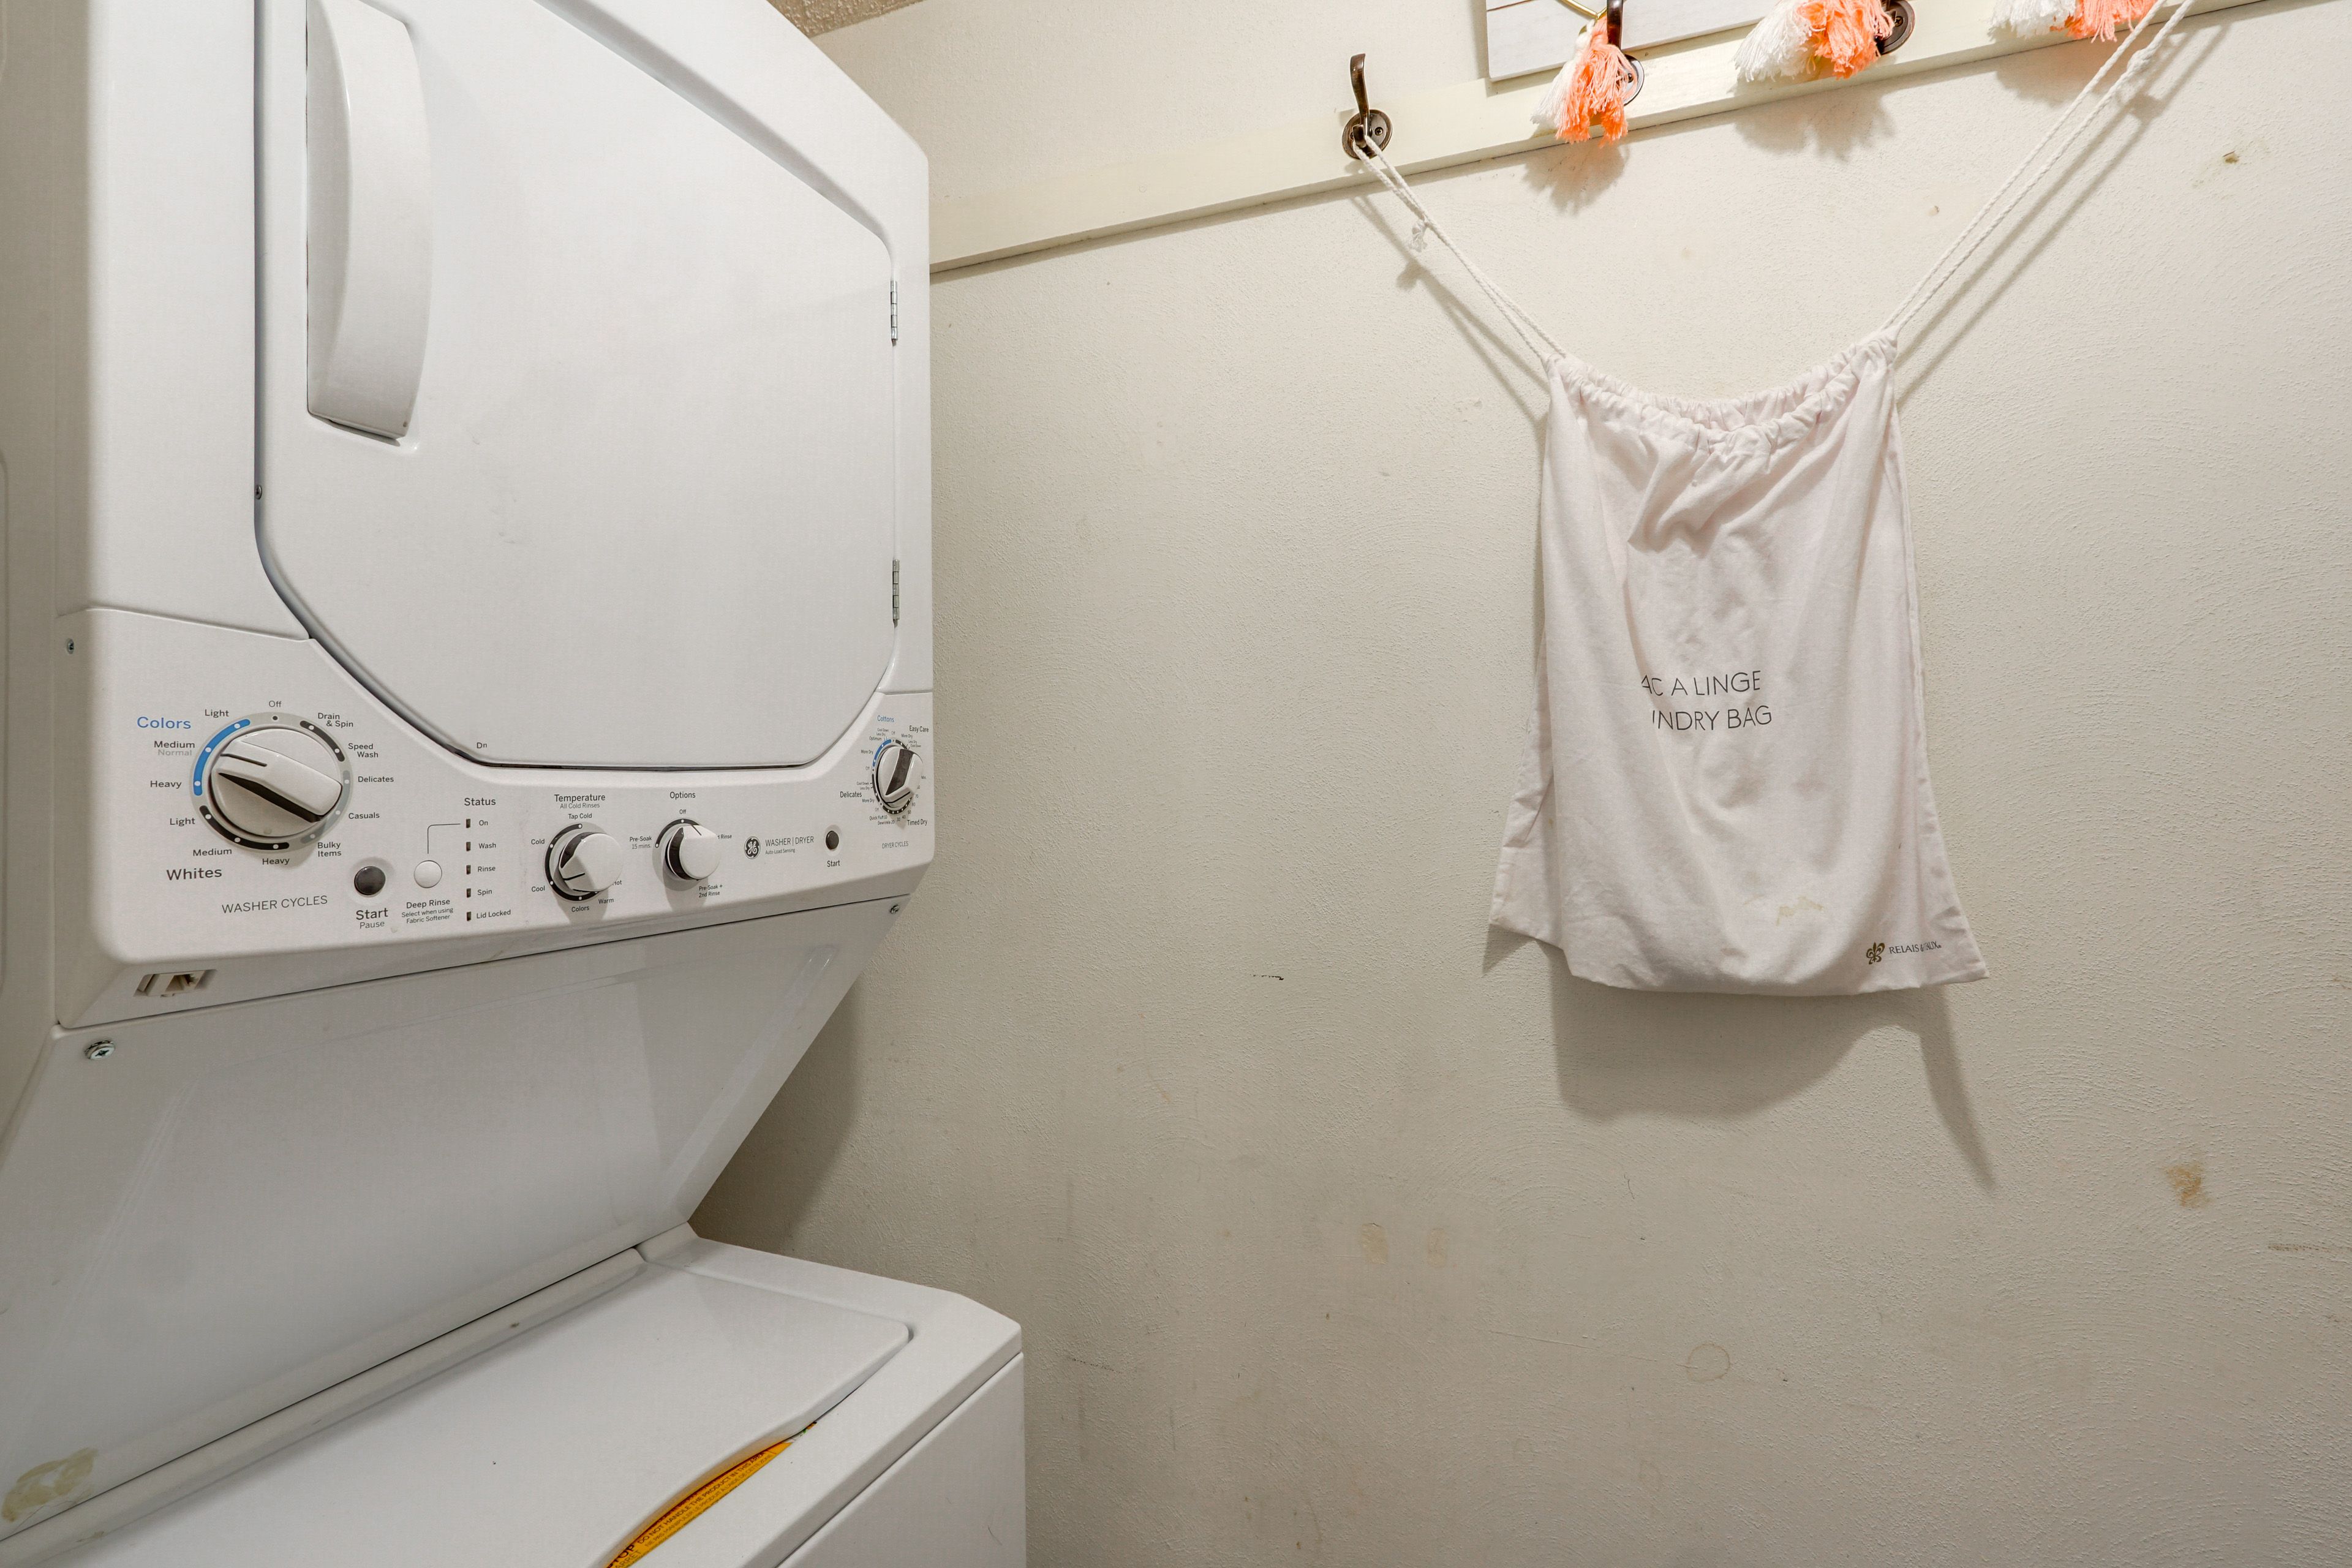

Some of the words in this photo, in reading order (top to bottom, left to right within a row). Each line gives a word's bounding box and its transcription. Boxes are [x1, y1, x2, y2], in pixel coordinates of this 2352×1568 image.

[1642, 675, 1663, 696] AC
[1672, 678, 1687, 696] A
[1694, 671, 1760, 695] LINGE
[205, 709, 228, 718] Light
[1653, 710, 1719, 730] NDRY
[1728, 706, 1771, 728] BAG
[137, 717, 190, 729] Colors
[151, 780, 181, 789] Heavy
[554, 794, 605, 803] Temperature
[670, 791, 695, 800] Options
[170, 818, 195, 826] Light
[766, 838, 791, 846] WASHER
[167, 869, 222, 880] Whites
[222, 900, 277, 913] WASHER
[281, 895, 327, 908] CYCLES
[356, 908, 388, 920] Start
[1889, 944, 1919, 954] RELAIS
[636, 1535, 651, 1544] DO
[647, 1524, 666, 1536] NOT
[662, 1505, 692, 1525] HANDLE
[688, 1496, 704, 1506] THE
[701, 1476, 732, 1497] PRODUCT
